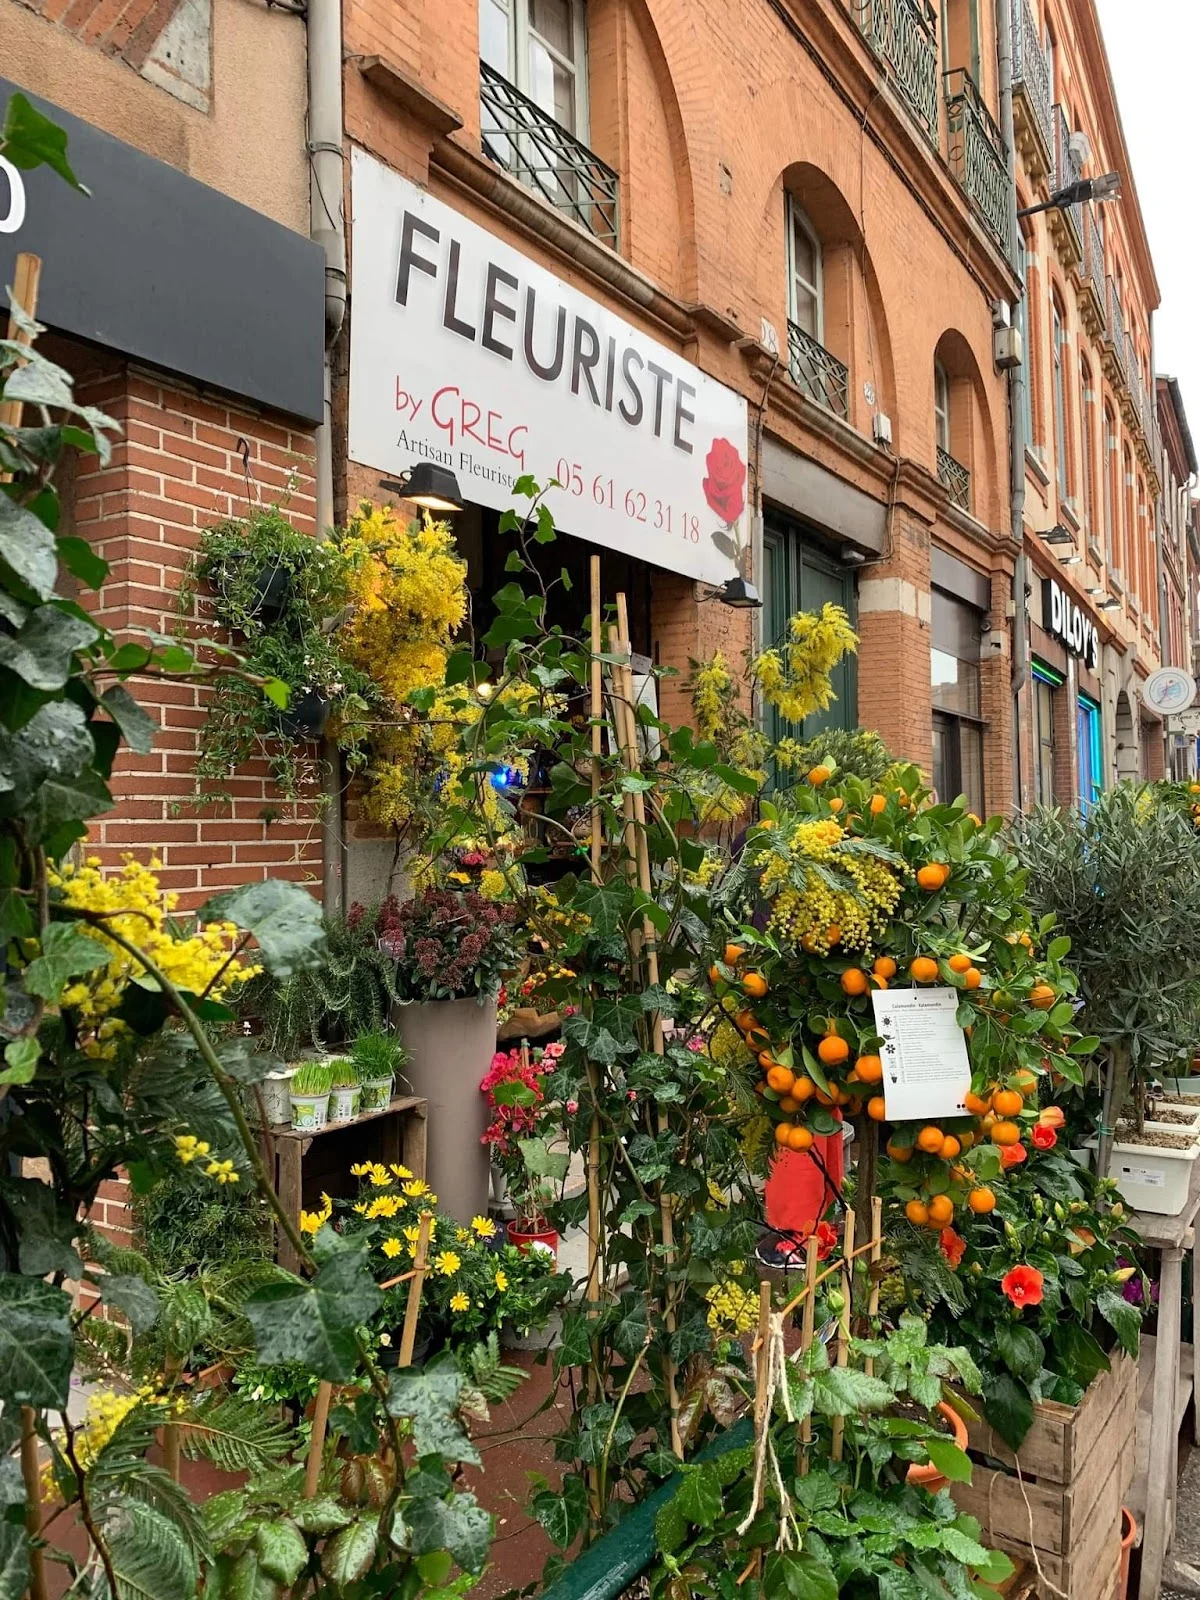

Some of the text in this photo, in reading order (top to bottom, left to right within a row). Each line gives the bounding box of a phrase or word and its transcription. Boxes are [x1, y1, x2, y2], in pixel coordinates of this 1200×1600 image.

[396, 210, 697, 455] FLEURISTE
[396, 375, 529, 472] by GREG
[397, 429, 453, 467] Artisan
[556, 457, 700, 544] 05 61 62 31 18
[1051, 579, 1099, 670] DILOY'S
